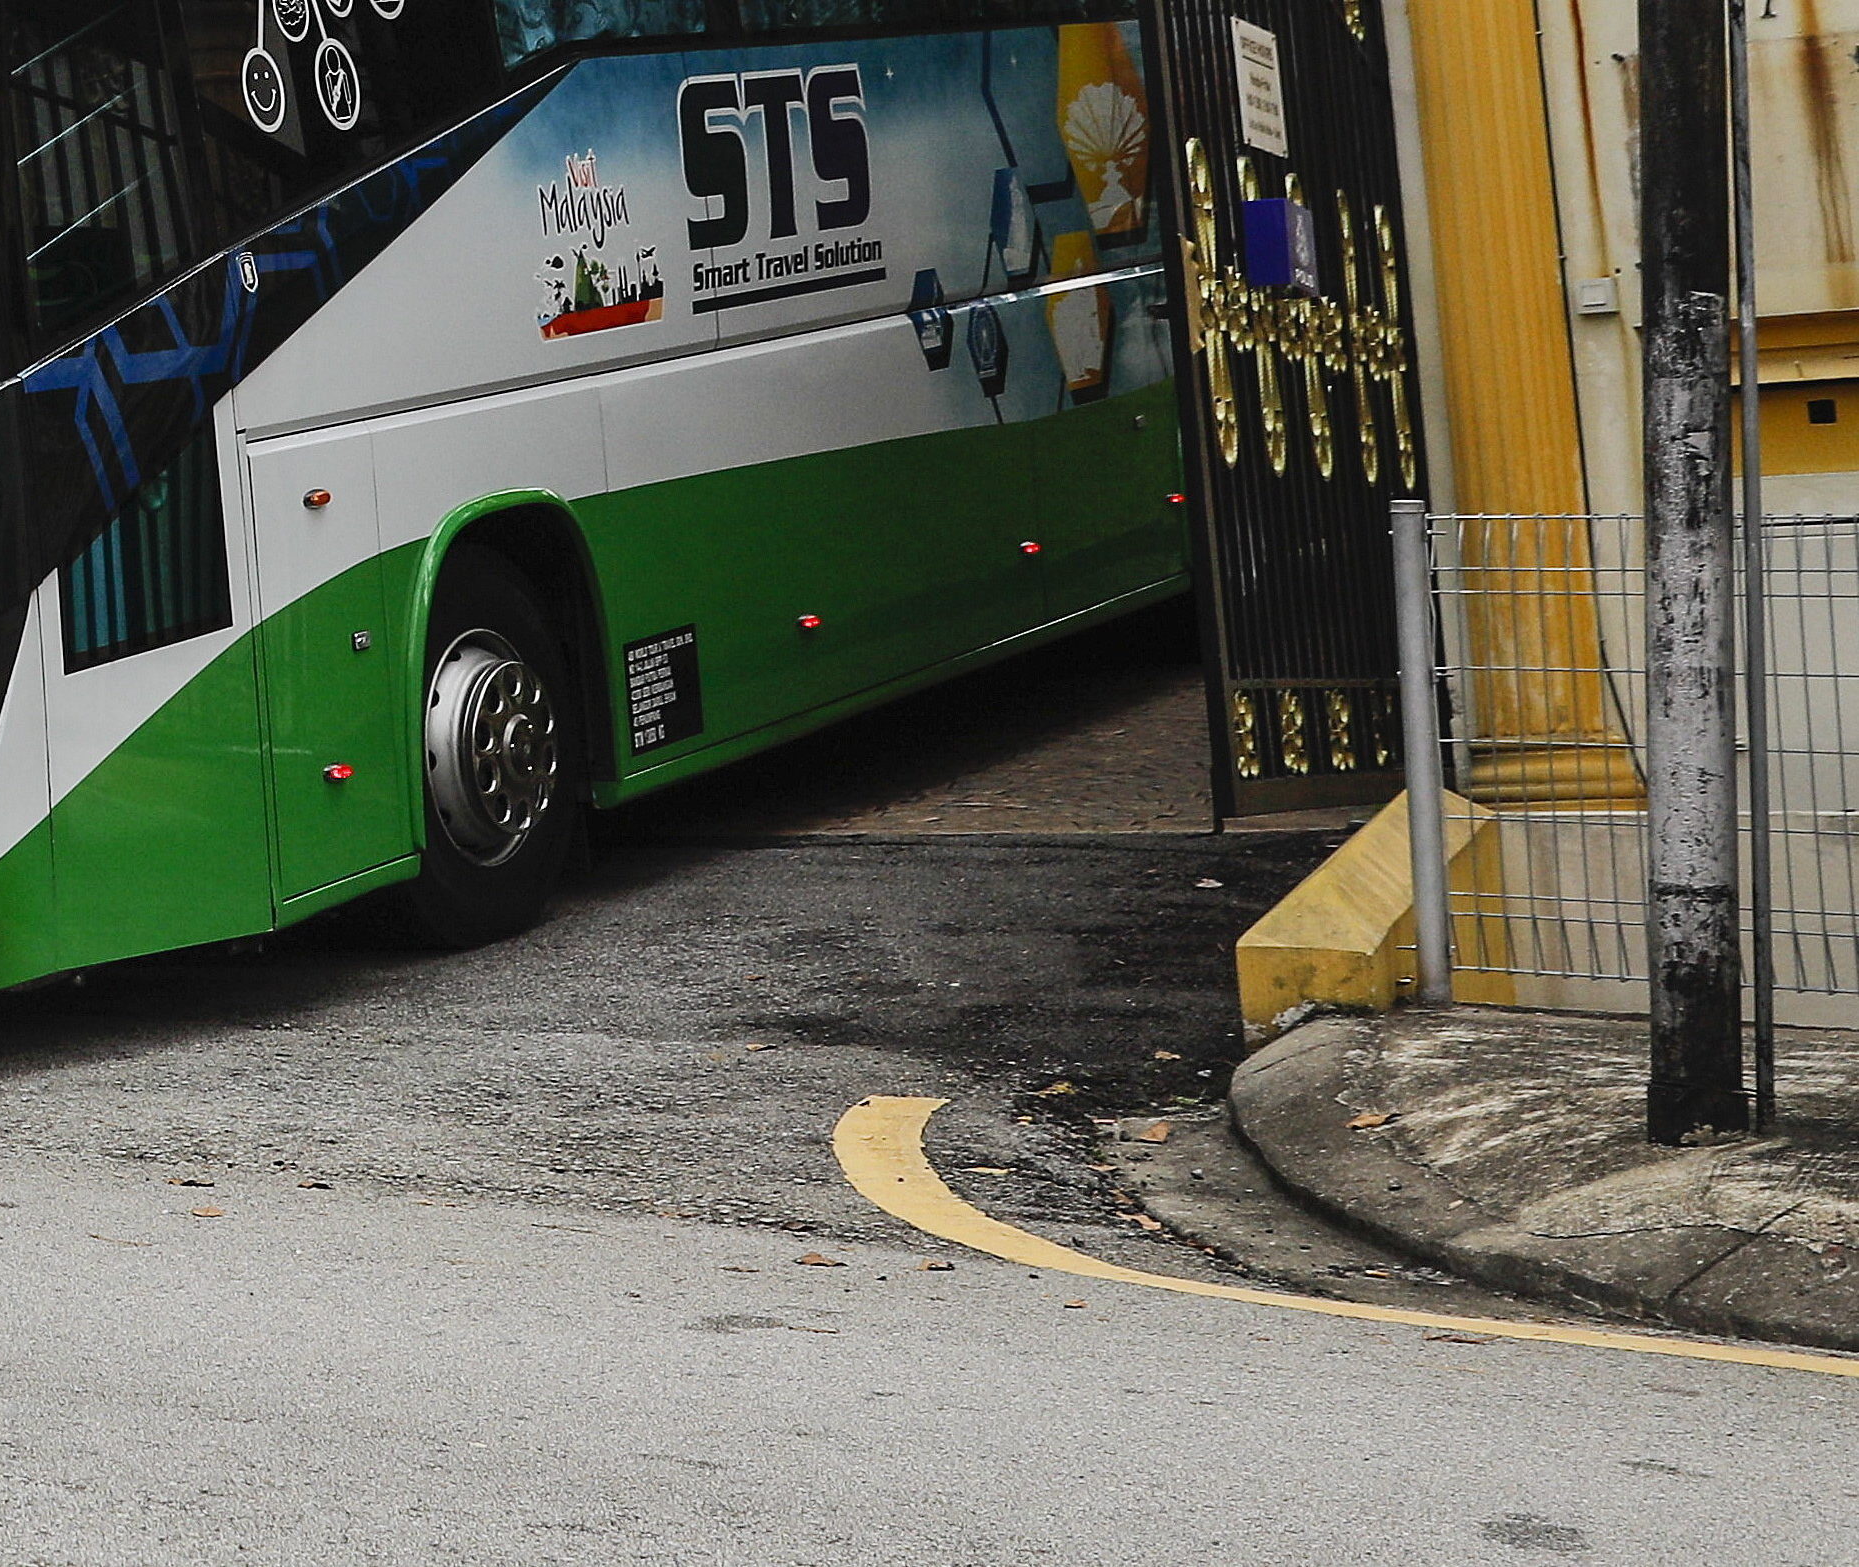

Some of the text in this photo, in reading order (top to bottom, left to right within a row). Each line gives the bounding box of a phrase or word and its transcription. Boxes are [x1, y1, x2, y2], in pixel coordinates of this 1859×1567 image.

[566, 149, 598, 188] Visit
[677, 63, 871, 252] STS
[538, 175, 630, 249] Malaysia
[692, 237, 882, 292] Smart Travel Solution
